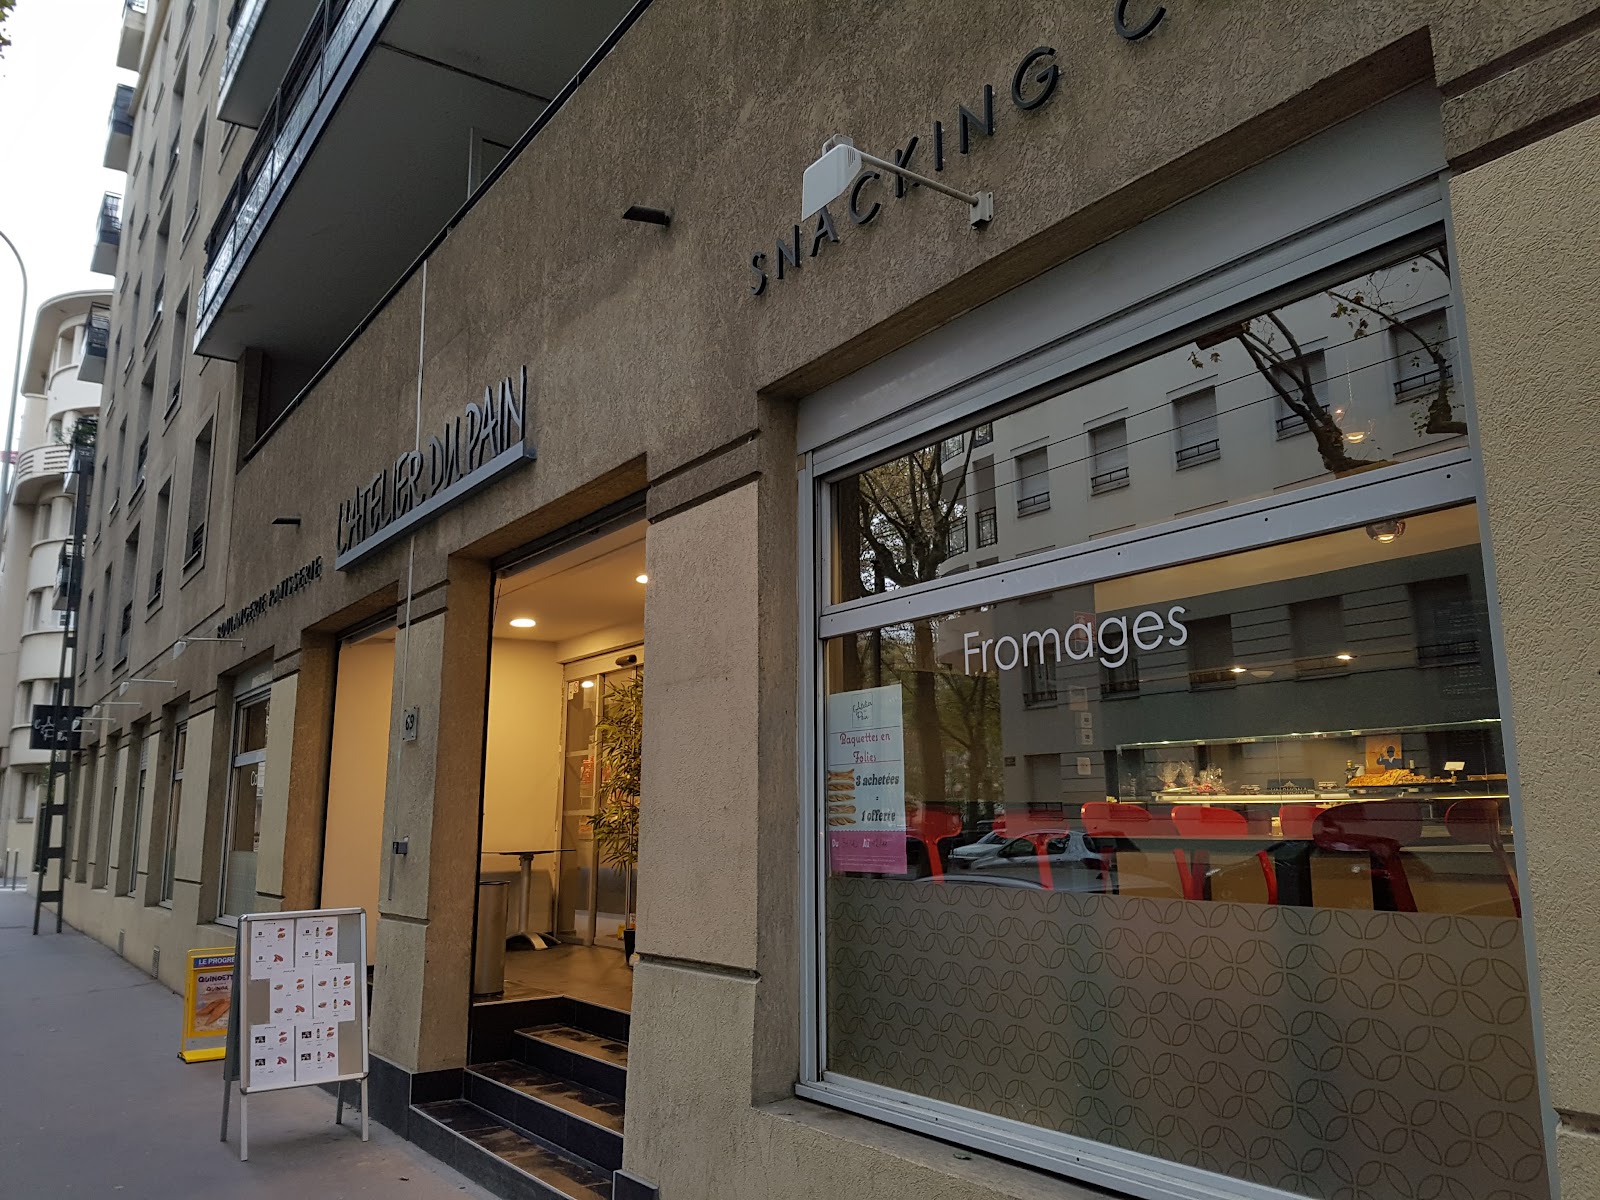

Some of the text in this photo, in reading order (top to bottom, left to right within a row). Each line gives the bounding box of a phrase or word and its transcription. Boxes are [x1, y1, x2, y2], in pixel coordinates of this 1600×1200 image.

[750, 46, 1059, 296] SNACKING
[337, 365, 528, 558] L'ATELIER DU PAIN
[963, 605, 1188, 675] Fromages
[405, 713, 415, 731] 69
[881, 733, 891, 741] en
[853, 750, 877, 763] Folies
[855, 772, 900, 787] 3 achetées
[861, 808, 896, 822] 1 offerte
